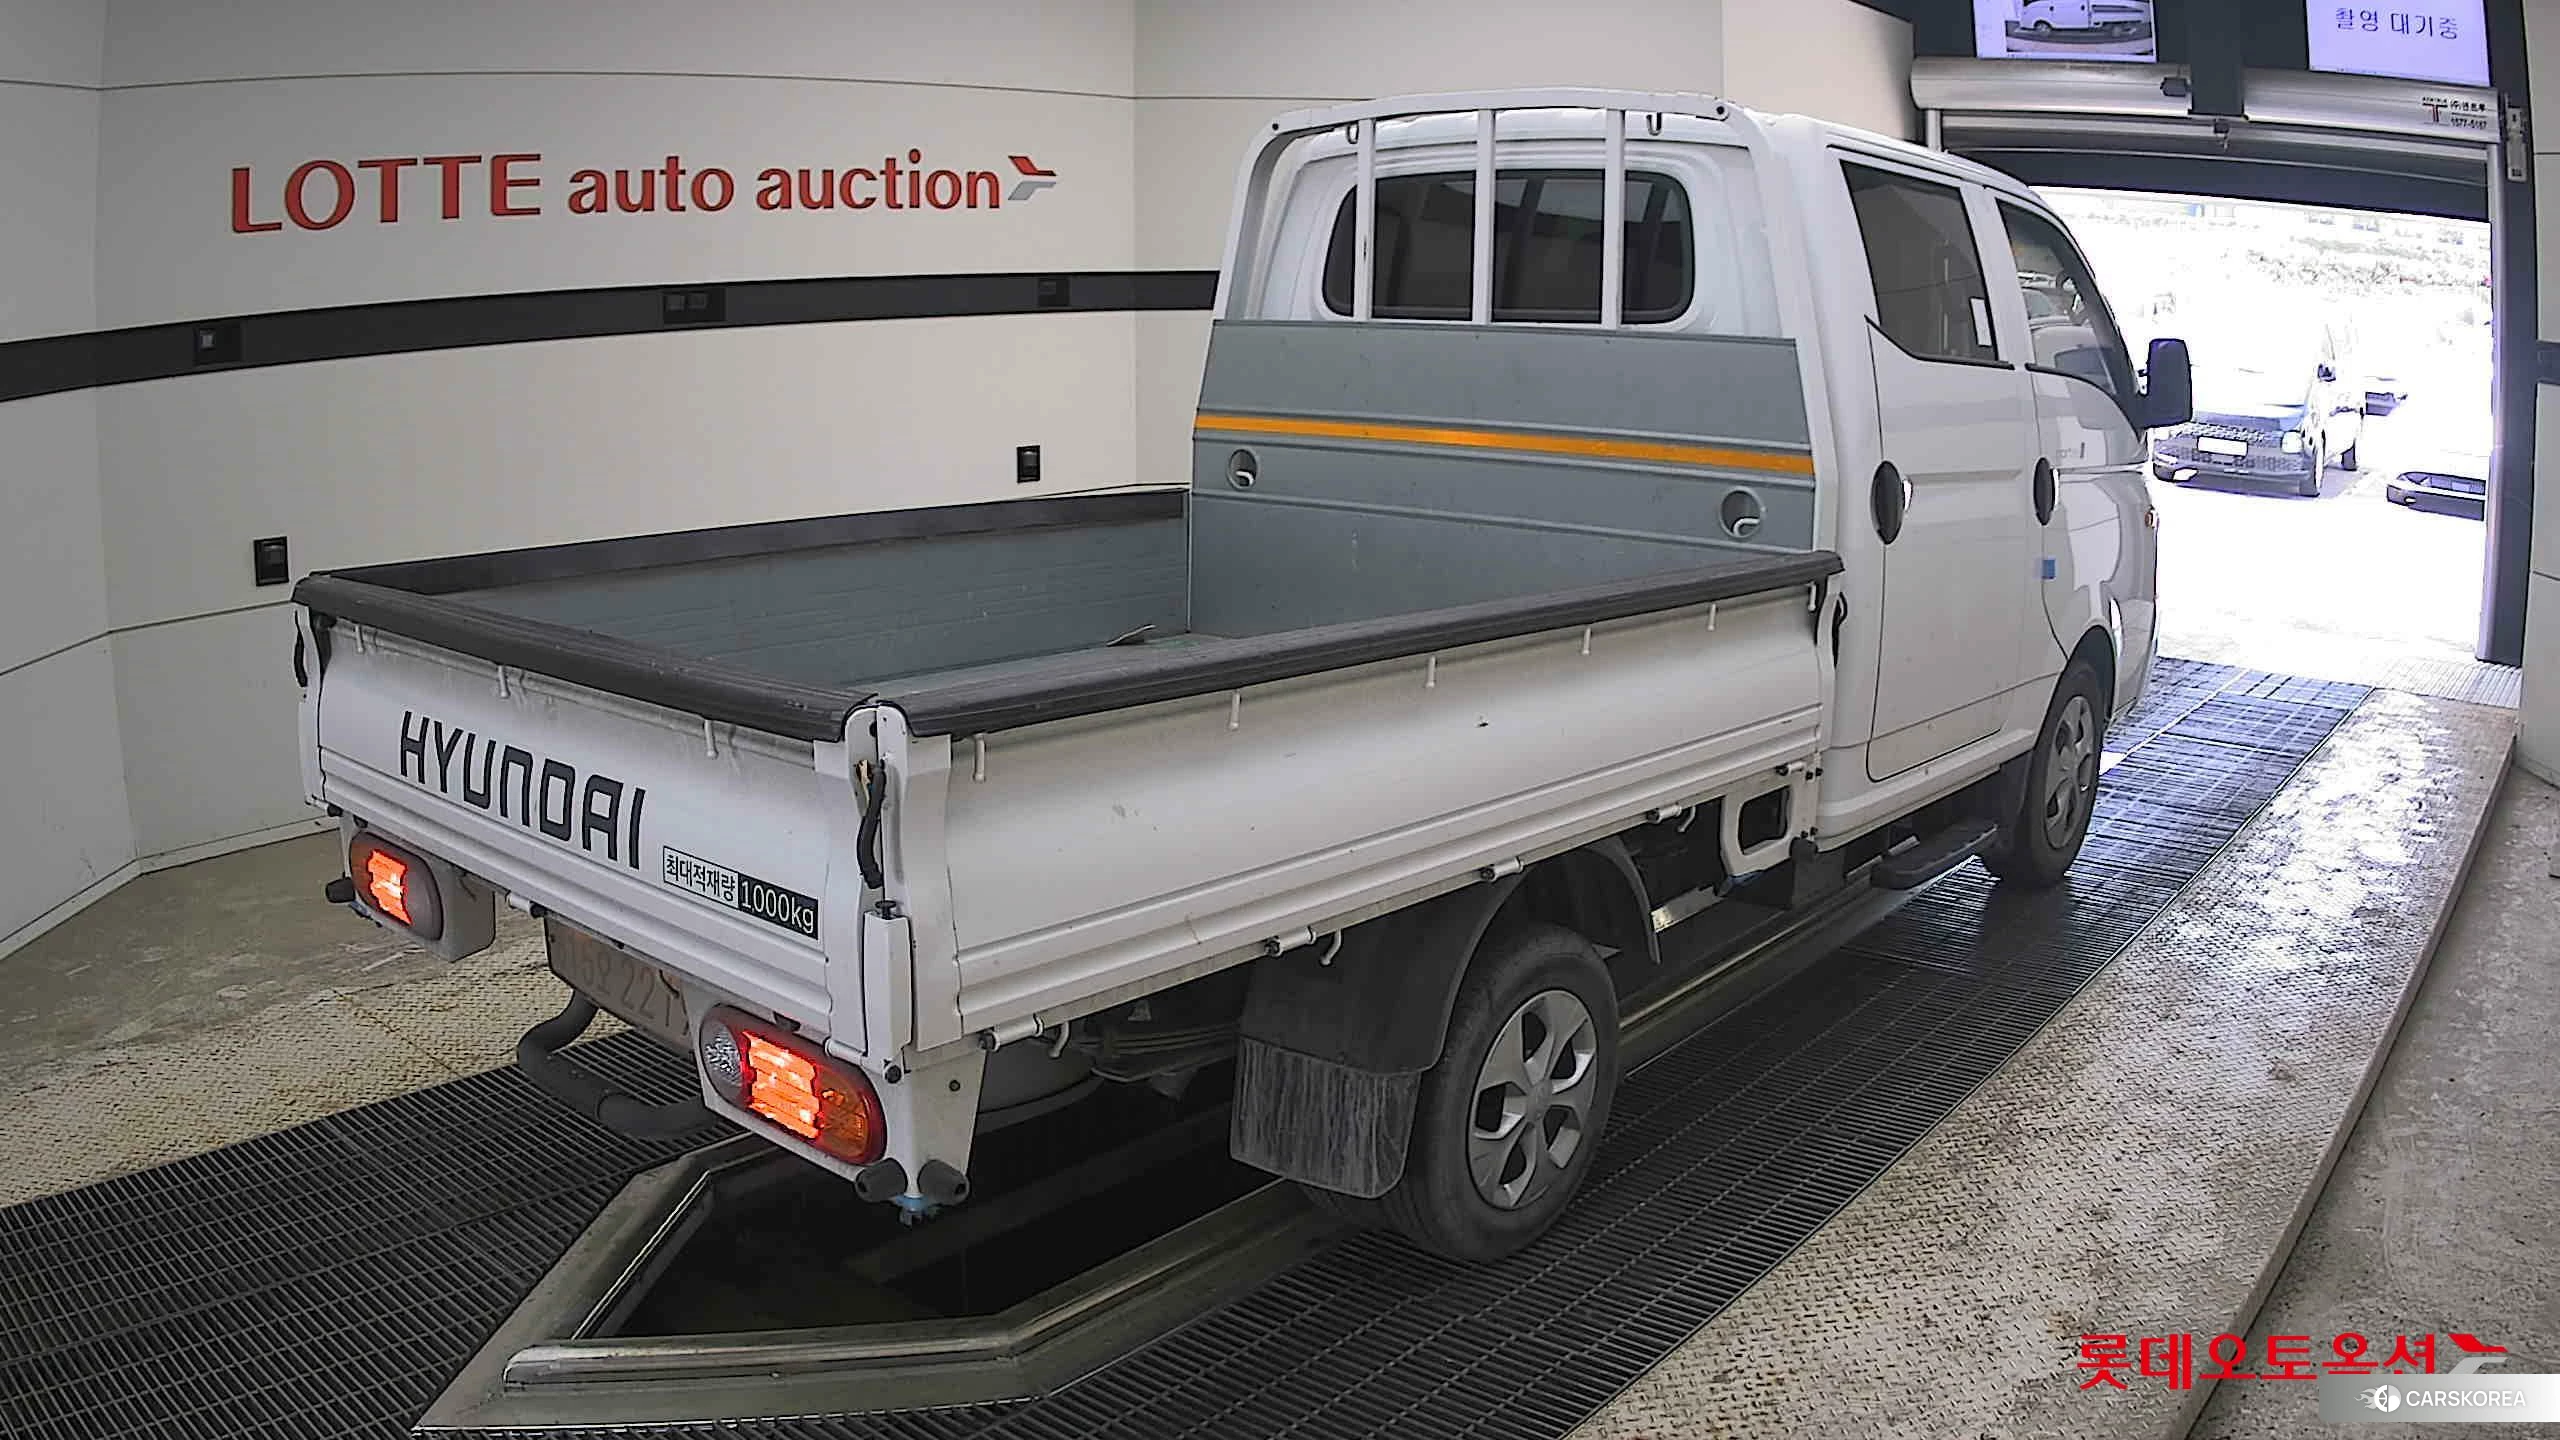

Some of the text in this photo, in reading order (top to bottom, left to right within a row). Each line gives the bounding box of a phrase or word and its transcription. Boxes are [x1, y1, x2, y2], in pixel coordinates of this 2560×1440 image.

[2336, 8, 2379, 32] 촬영
[231, 148, 1002, 234] LOTTE auto auction
[401, 710, 647, 871] HYUNDAI
[665, 854, 737, 902] 최대적재량
